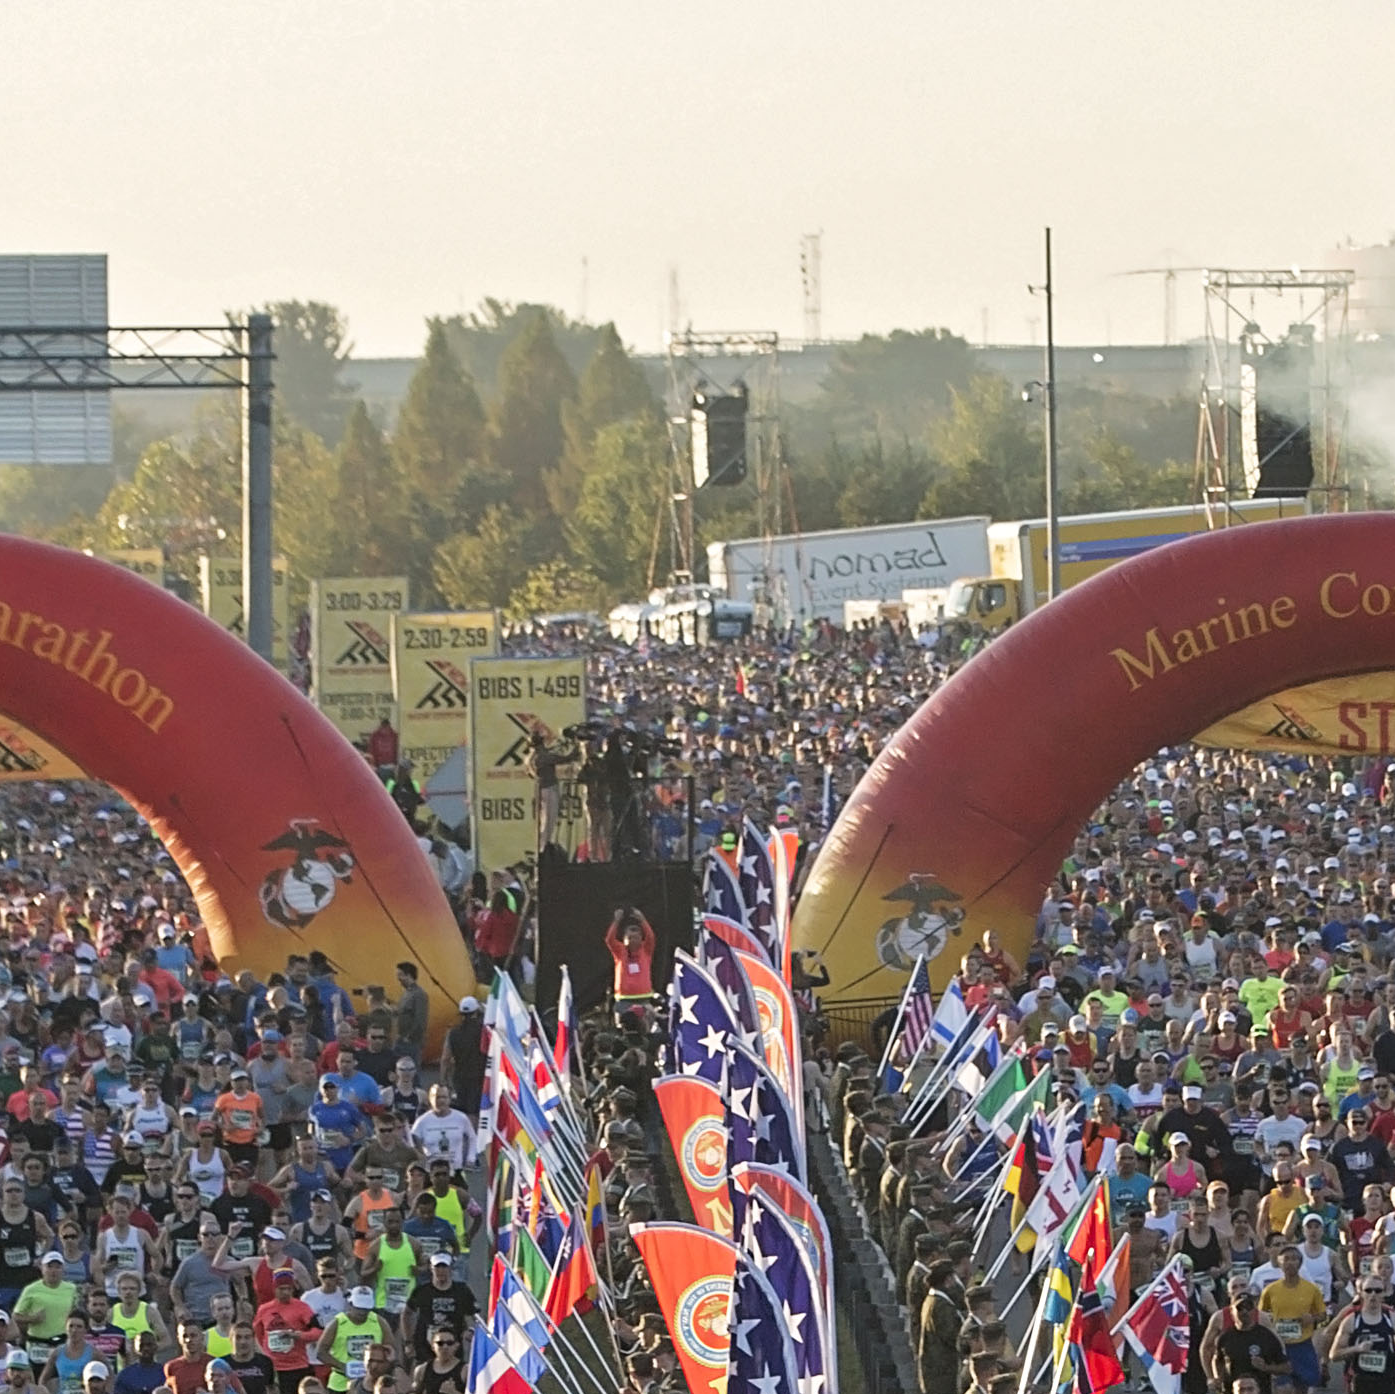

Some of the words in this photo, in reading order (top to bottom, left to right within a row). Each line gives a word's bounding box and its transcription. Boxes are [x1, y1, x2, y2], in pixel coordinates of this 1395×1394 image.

[808, 531, 947, 580] nomad
[810, 579, 863, 600] Event
[868, 572, 947, 602] Systems
[404, 627, 488, 649] 2:30-2:59
[1109, 595, 1298, 692] Marine
[478, 676, 522, 700] BIBS
[528, 675, 581, 699] 1-499
[481, 797, 525, 821] BIBS
